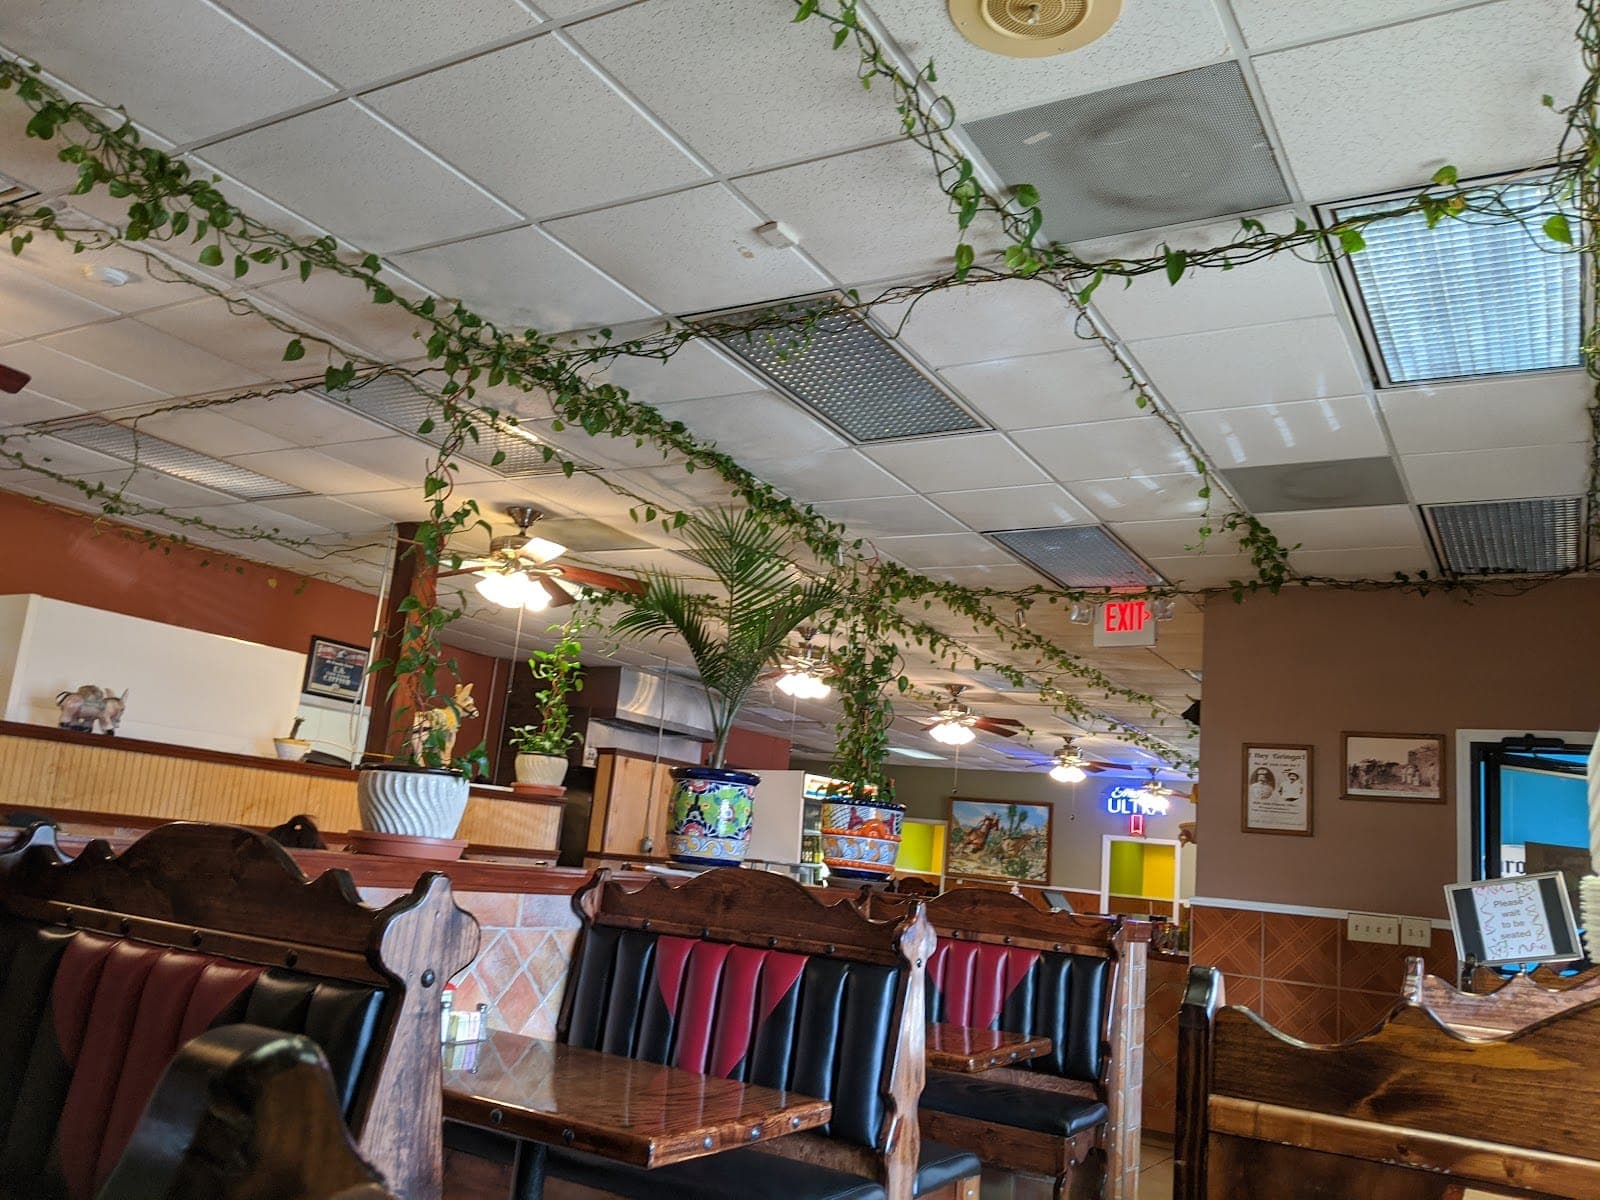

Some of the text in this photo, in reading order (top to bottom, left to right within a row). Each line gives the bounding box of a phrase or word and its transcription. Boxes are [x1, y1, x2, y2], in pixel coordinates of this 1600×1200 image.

[1104, 601, 1146, 632] EXIT
[1493, 899, 1523, 908] Please
[1501, 909, 1521, 918] wait
[1501, 920, 1525, 929] to be
[1500, 930, 1531, 940] seated
